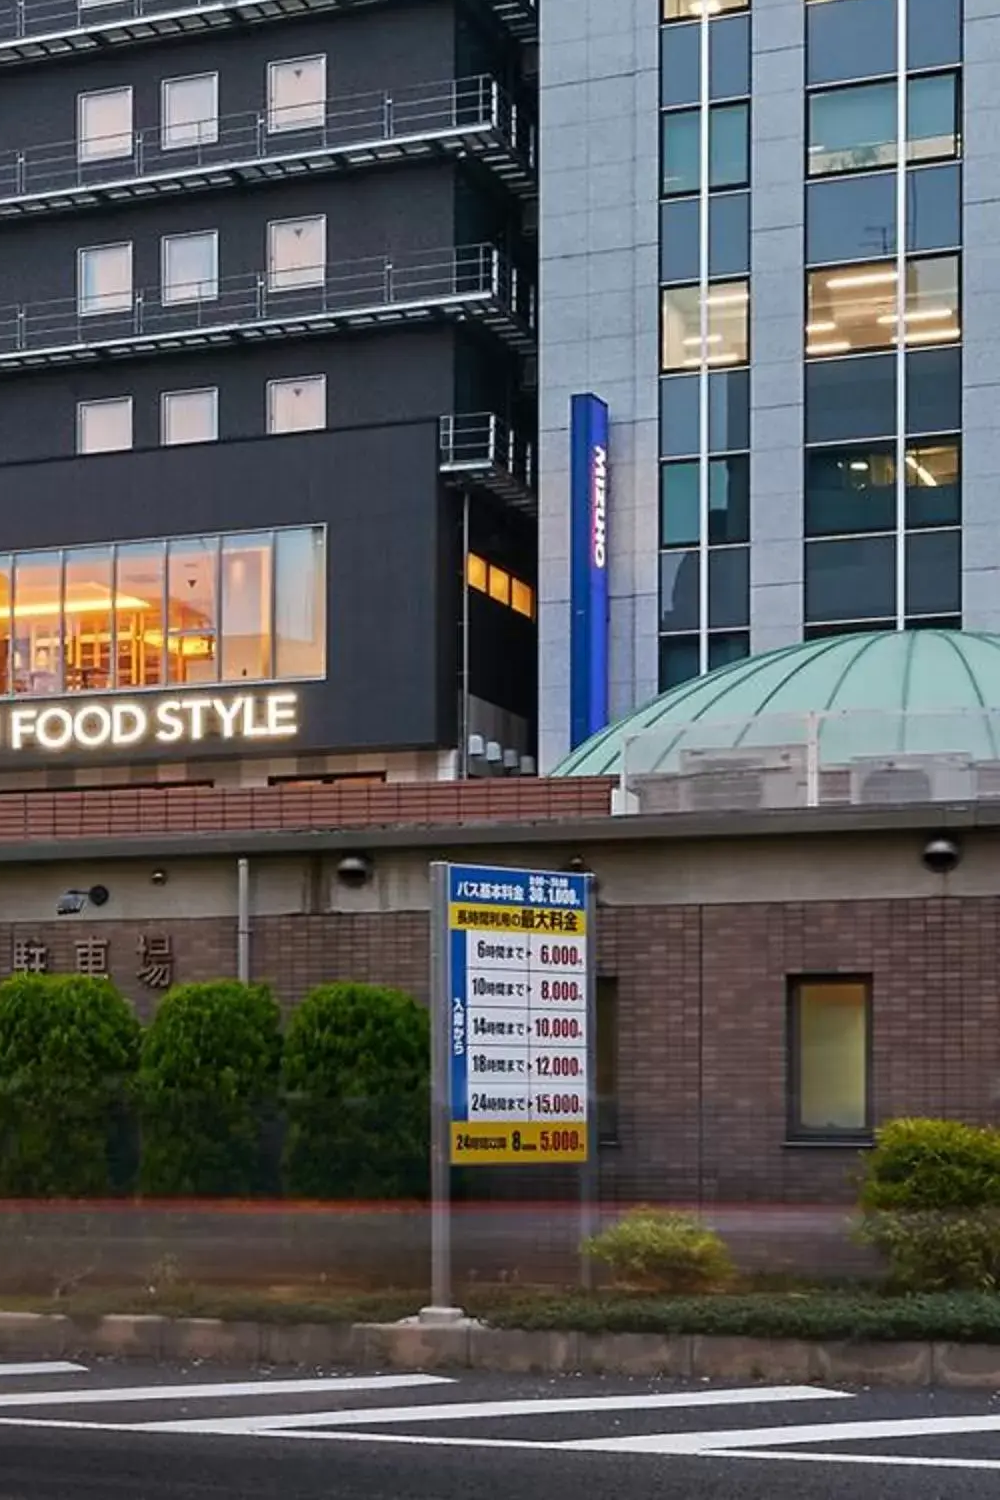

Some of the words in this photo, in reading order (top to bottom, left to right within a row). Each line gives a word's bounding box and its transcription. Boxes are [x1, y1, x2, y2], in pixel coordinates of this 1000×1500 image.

[594, 445, 606, 569] MIZUHO
[11, 702, 148, 750] FOOD
[156, 692, 298, 742] STYLE
